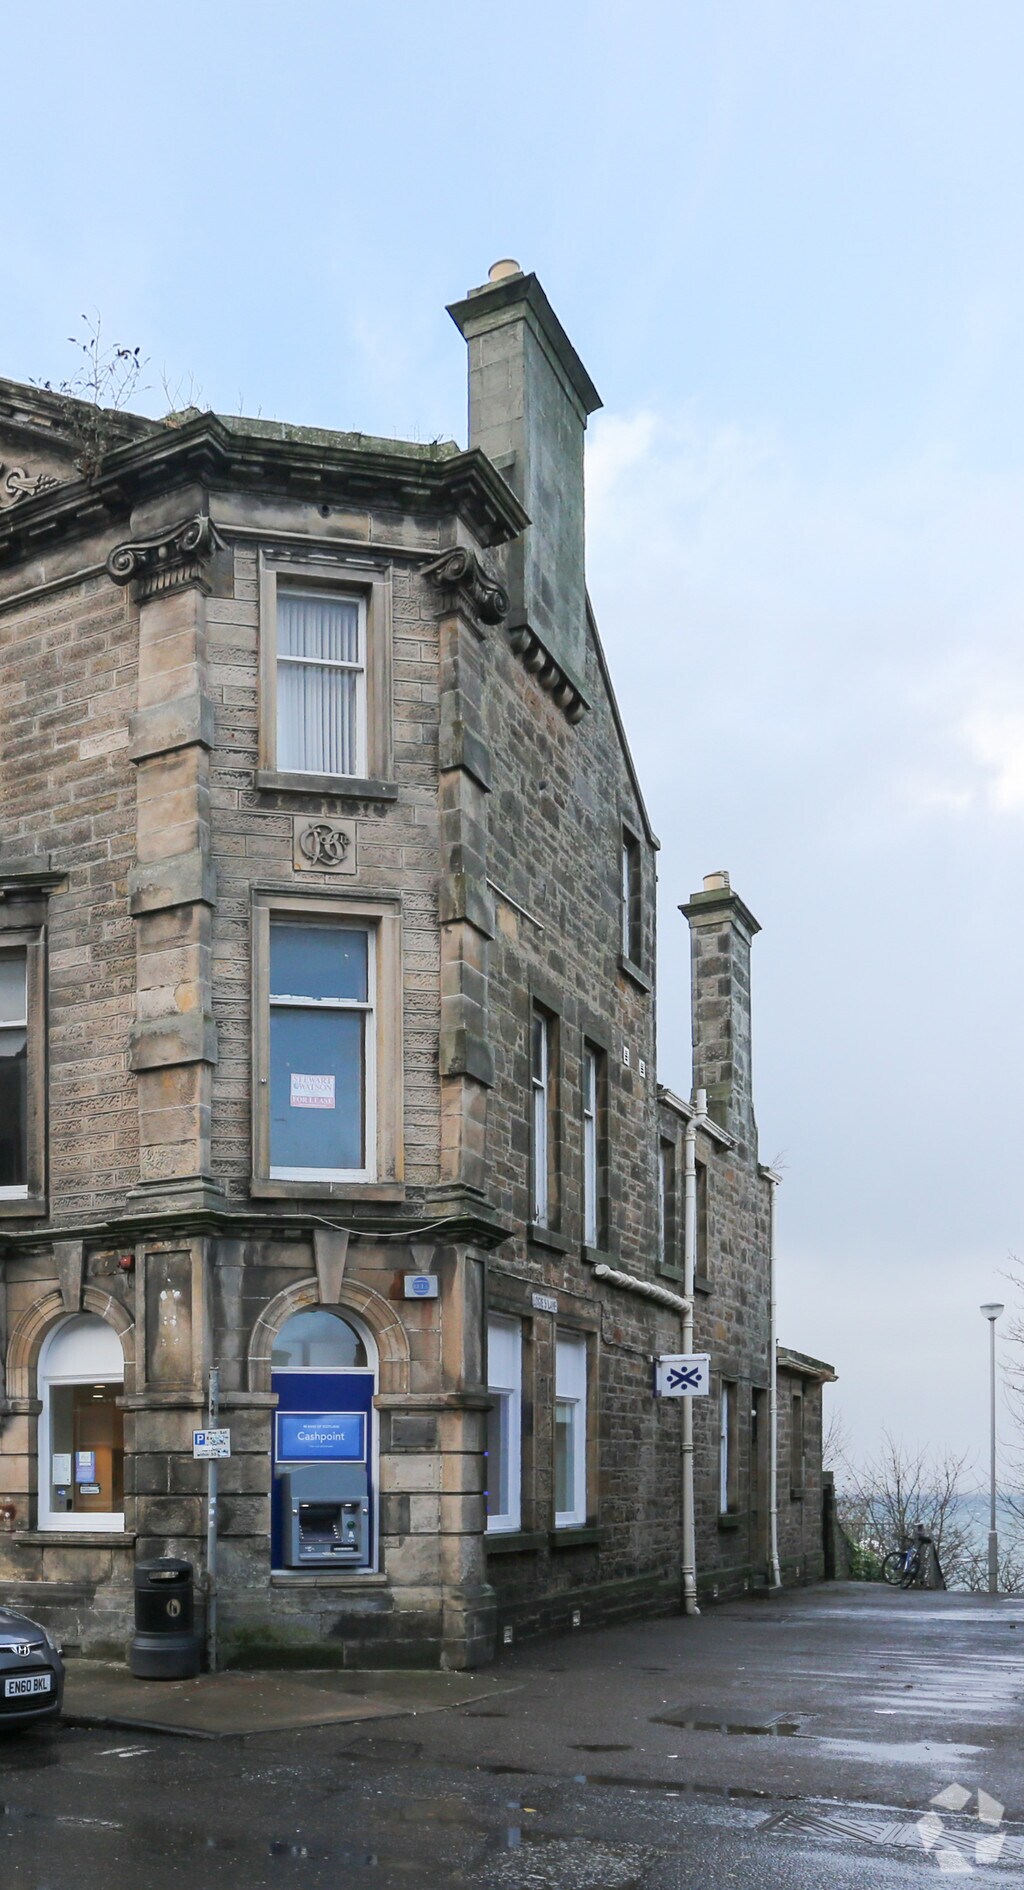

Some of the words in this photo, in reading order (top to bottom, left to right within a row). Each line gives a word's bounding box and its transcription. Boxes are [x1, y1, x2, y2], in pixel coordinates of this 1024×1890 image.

[196, 1434, 204, 1445] P
[297, 1431, 345, 1443] Cashpoint
[8, 1680, 32, 1695] EN60
[33, 1678, 47, 1691] BKL
